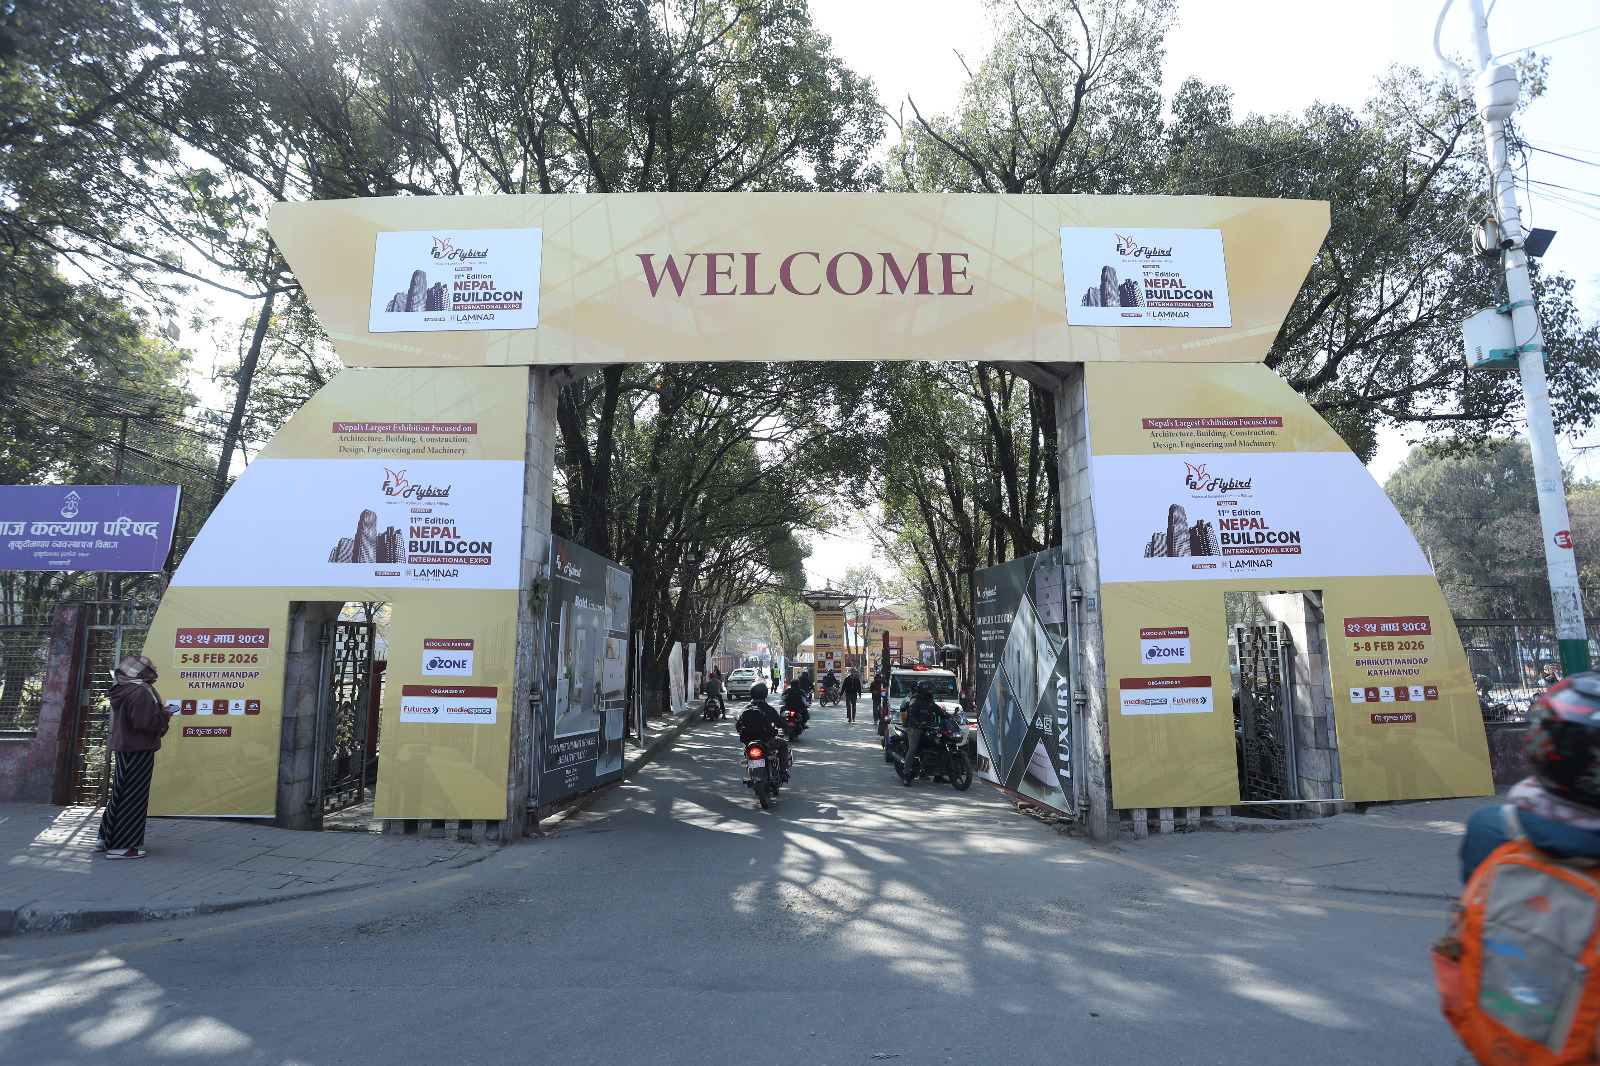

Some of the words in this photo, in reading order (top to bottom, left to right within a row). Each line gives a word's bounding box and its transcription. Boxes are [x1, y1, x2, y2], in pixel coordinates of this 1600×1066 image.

[448, 248, 488, 261] Flybird
[1134, 246, 1173, 258] Flybird
[635, 251, 974, 298] WELCOME
[454, 280, 496, 291] NEPAL
[1144, 278, 1186, 288] NEPAL
[453, 291, 523, 302] BUILDCON
[1146, 290, 1213, 300] BUILDCON
[365, 424, 391, 433] Largest
[1175, 420, 1200, 428] Largest
[367, 446, 410, 455] Engineering
[1180, 441, 1223, 450] Engineering
[1206, 478, 1252, 492] Flybird
[403, 485, 451, 500] Flybird
[30, 521, 99, 537] कल्याण
[1219, 518, 1269, 530] NEPAL
[409, 526, 460, 539] NEPAL
[1220, 531, 1301, 545] BUILDCON
[95, 540, 119, 549] विभाग
[409, 541, 492, 554] BUILDCON
[1229, 560, 1272, 568] LAMINAR
[414, 569, 459, 577] LAMINAR
[1348, 624, 1377, 633] २२-२५
[1380, 623, 1400, 632] माघ
[1402, 623, 1427, 631] २०८२
[214, 634, 235, 644] माघ
[238, 634, 265, 644] २०८२
[1354, 643, 1371, 651] 5-8
[1374, 642, 1394, 651] FEB
[1397, 641, 1425, 650] 2026
[181, 654, 200, 664] 5-8
[203, 654, 226, 663] FEB
[228, 654, 258, 663] 2026
[446, 707, 491, 715] mediaspace
[1056, 672, 1070, 778] LUXURY
